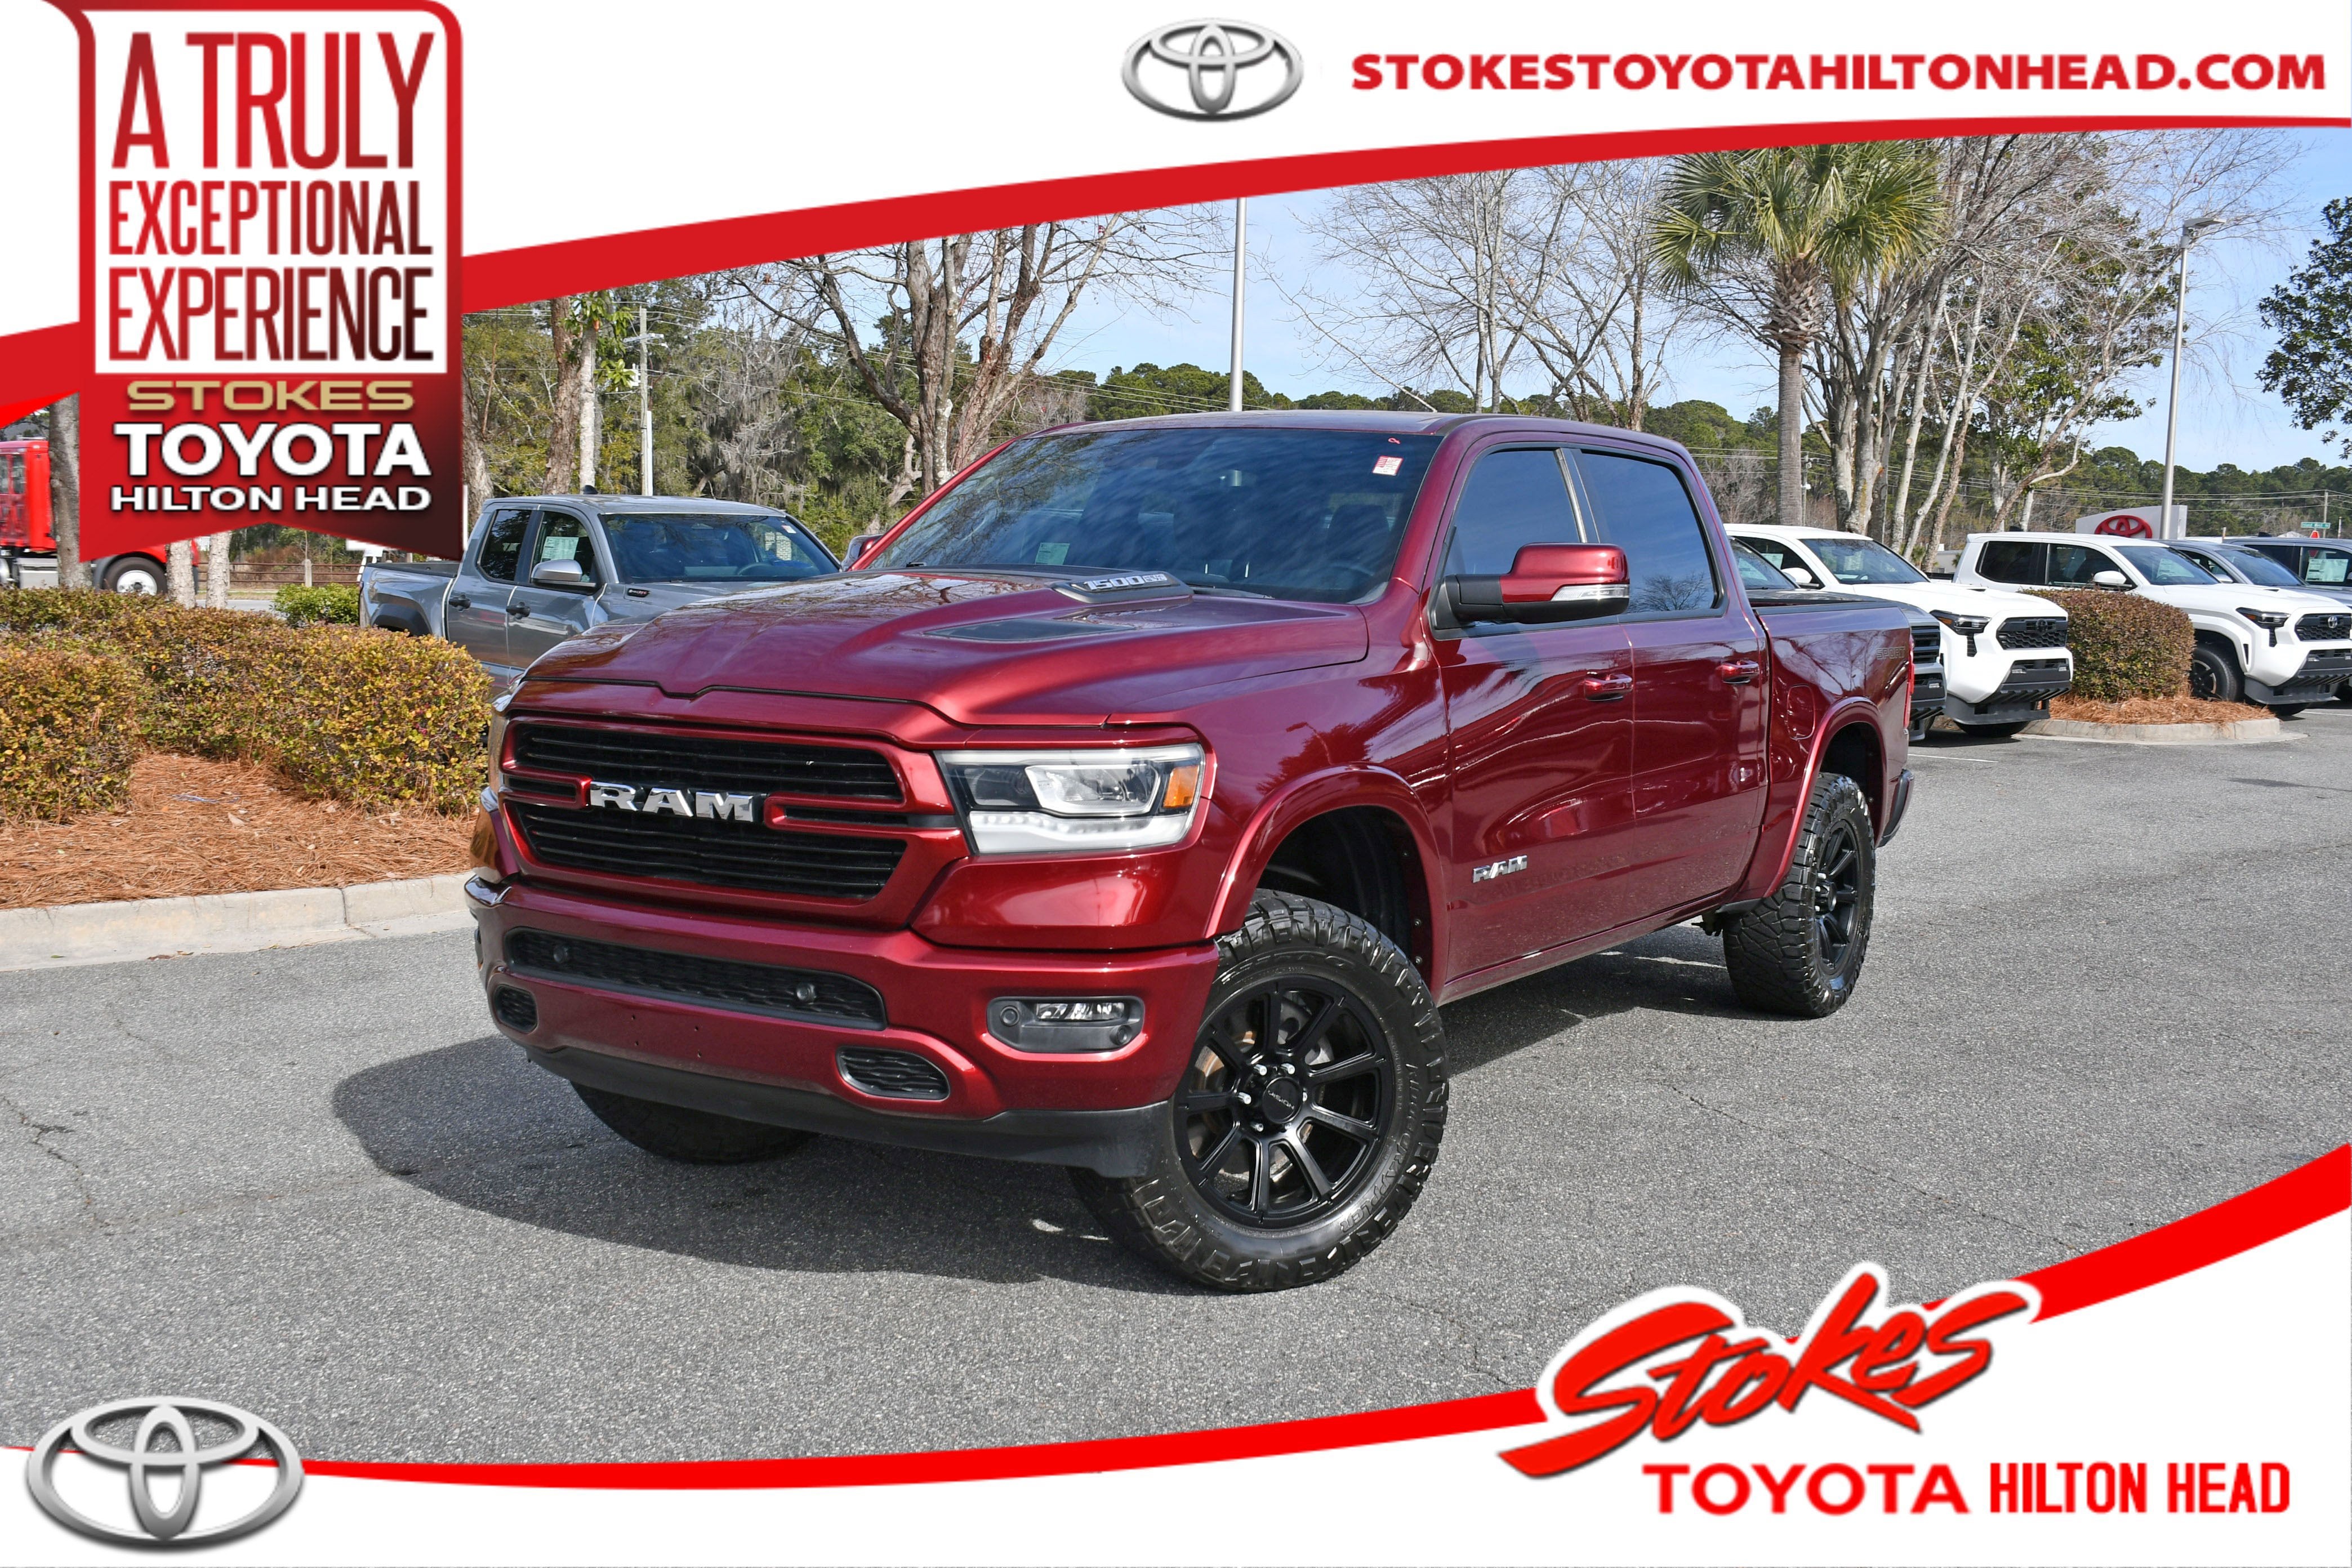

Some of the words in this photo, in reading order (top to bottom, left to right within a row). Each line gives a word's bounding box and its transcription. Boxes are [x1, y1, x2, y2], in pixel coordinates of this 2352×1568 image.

[1084, 576, 1145, 590] 1500
[1876, 646, 1906, 660] SPORT
[590, 781, 754, 822] RAM
[1472, 855, 1527, 884] RAM
